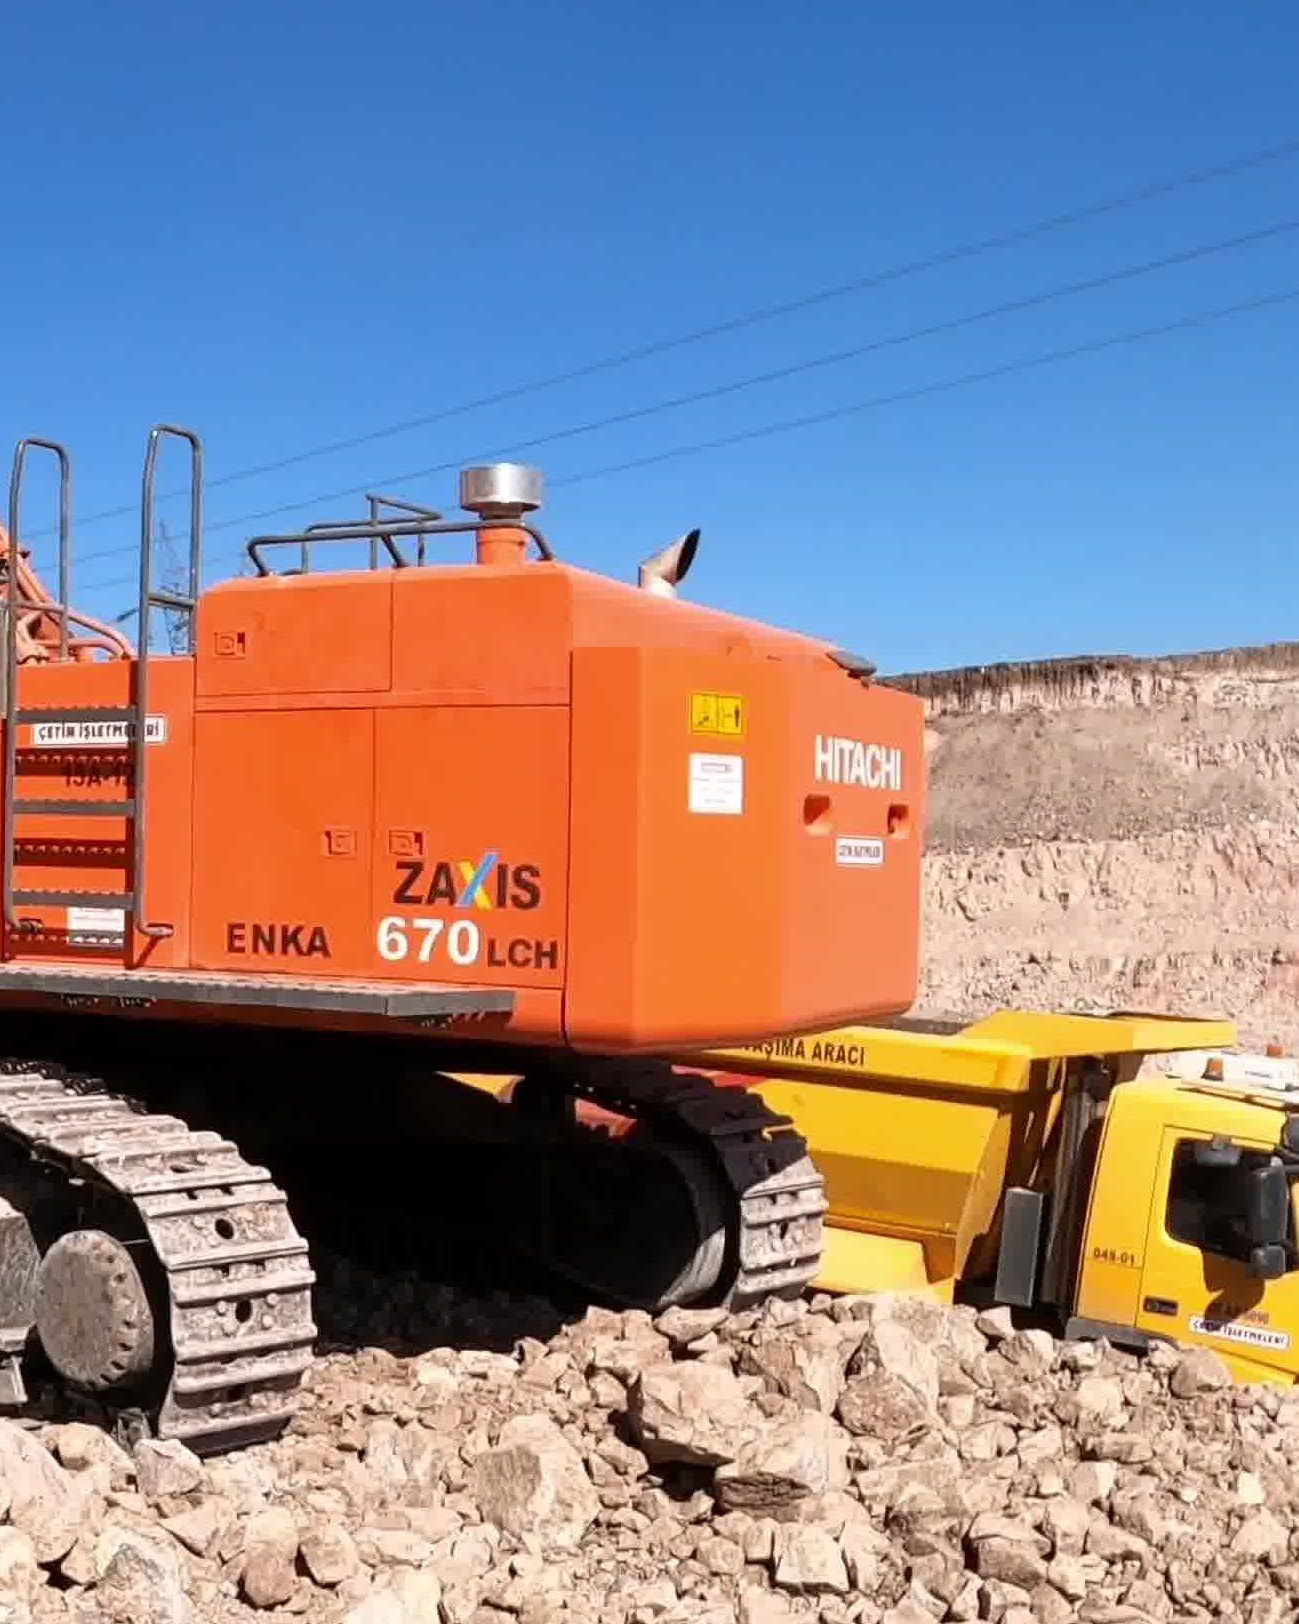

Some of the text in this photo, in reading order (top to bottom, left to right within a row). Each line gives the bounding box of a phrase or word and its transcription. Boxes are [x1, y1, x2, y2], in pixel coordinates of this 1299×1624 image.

[814, 734, 902, 791] HITACHI
[393, 849, 542, 910] ZAXIS
[227, 923, 332, 960] ENKA
[376, 917, 558, 970] 670 LCH
